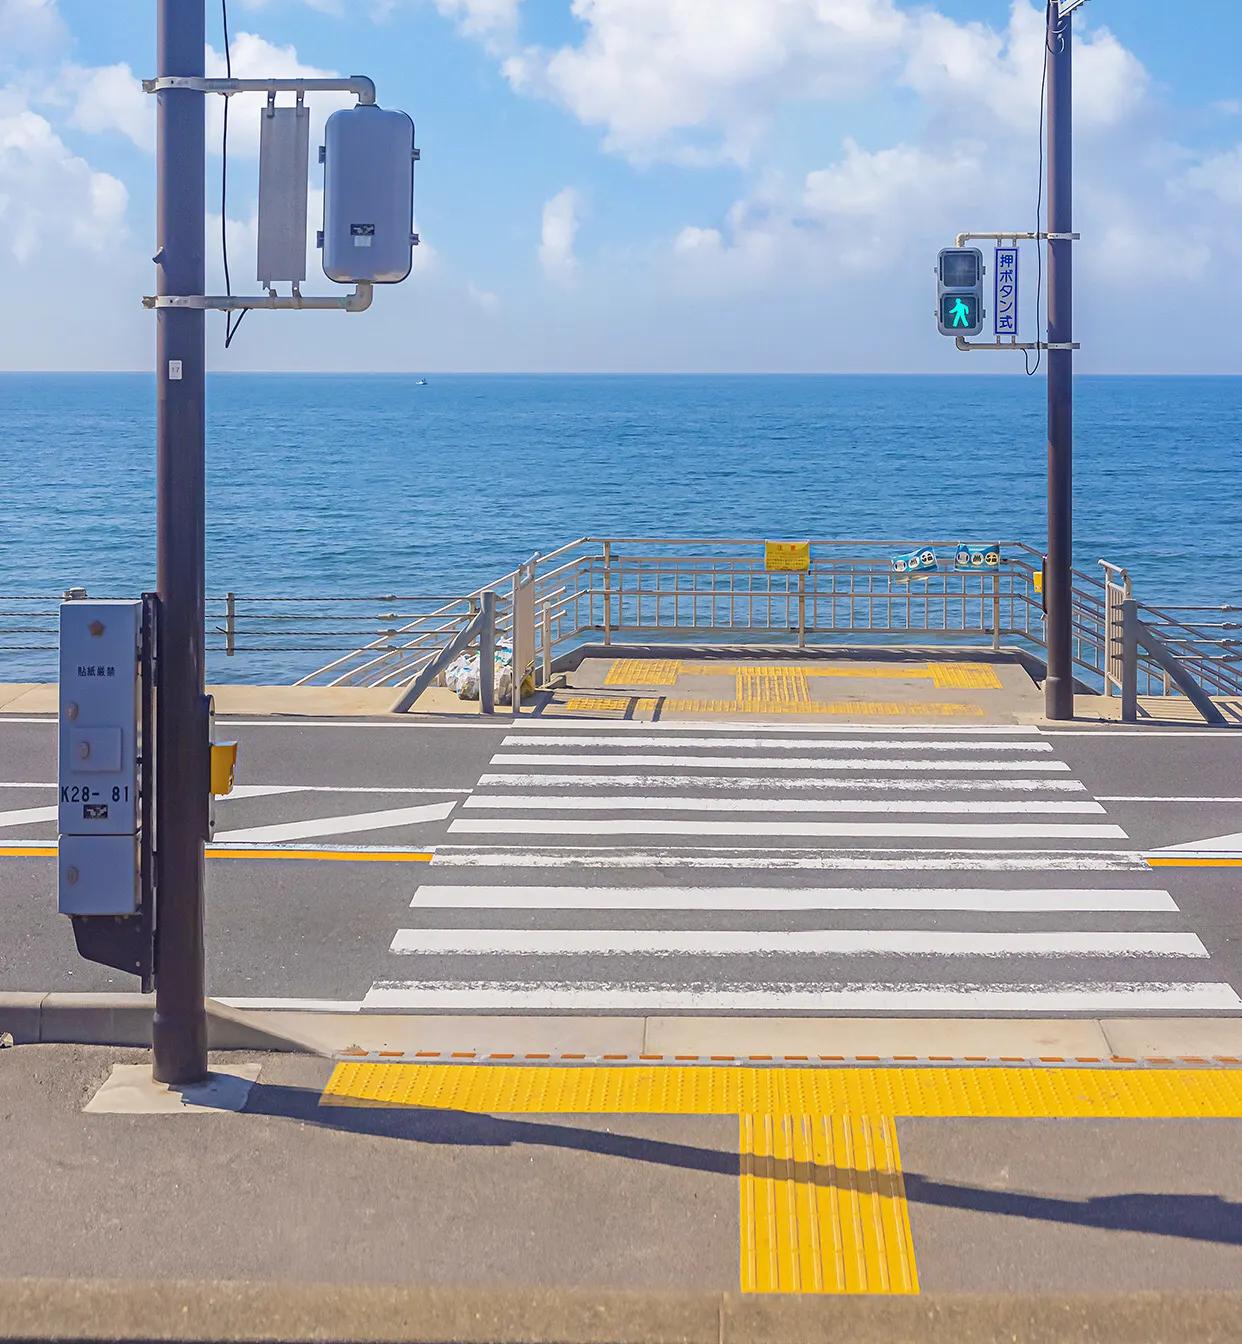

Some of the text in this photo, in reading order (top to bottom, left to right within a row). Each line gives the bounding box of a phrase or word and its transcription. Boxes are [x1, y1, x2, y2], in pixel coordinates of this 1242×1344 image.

[999, 254, 1014, 329] 押ボタン式
